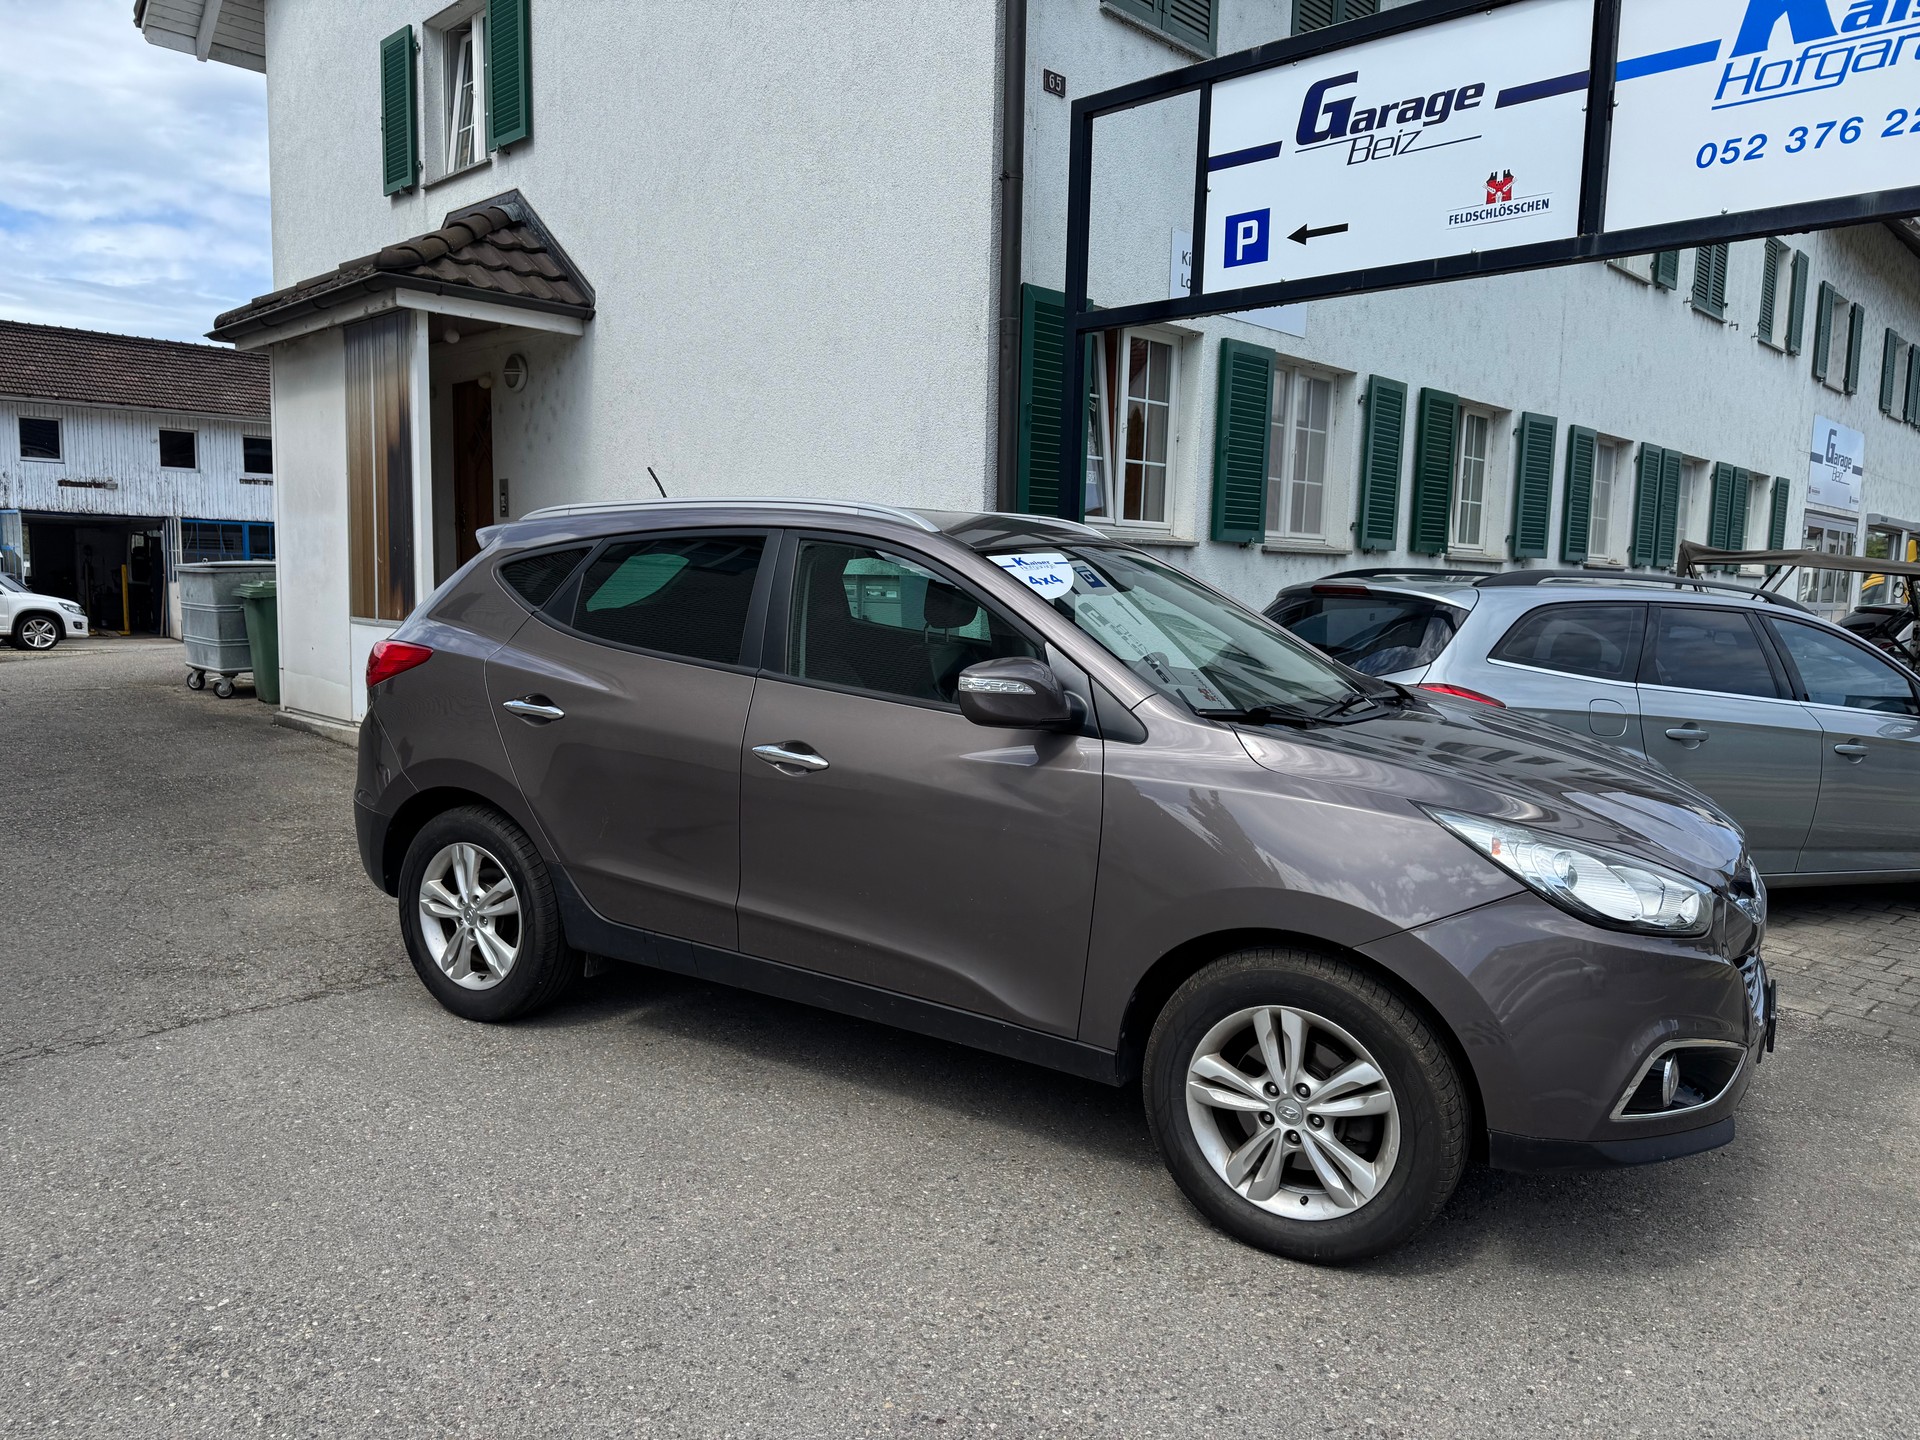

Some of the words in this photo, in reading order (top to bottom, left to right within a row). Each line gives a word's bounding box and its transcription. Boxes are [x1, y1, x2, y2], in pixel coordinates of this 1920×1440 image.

[1049, 74, 1062, 91] 65
[1714, 32, 1920, 100] Hofgar
[1296, 71, 1486, 146] Garage
[1346, 131, 1424, 165] Beiz
[1696, 133, 1768, 168] 052
[1785, 116, 1864, 153] 376
[1448, 198, 1550, 225] FELDSCHLÖSSCHEN
[1236, 219, 1259, 261] P
[1181, 250, 1192, 267] Ki
[1180, 273, 1191, 289] Lo
[1826, 428, 1852, 472] Garage
[1028, 574, 1064, 586] 4x4
